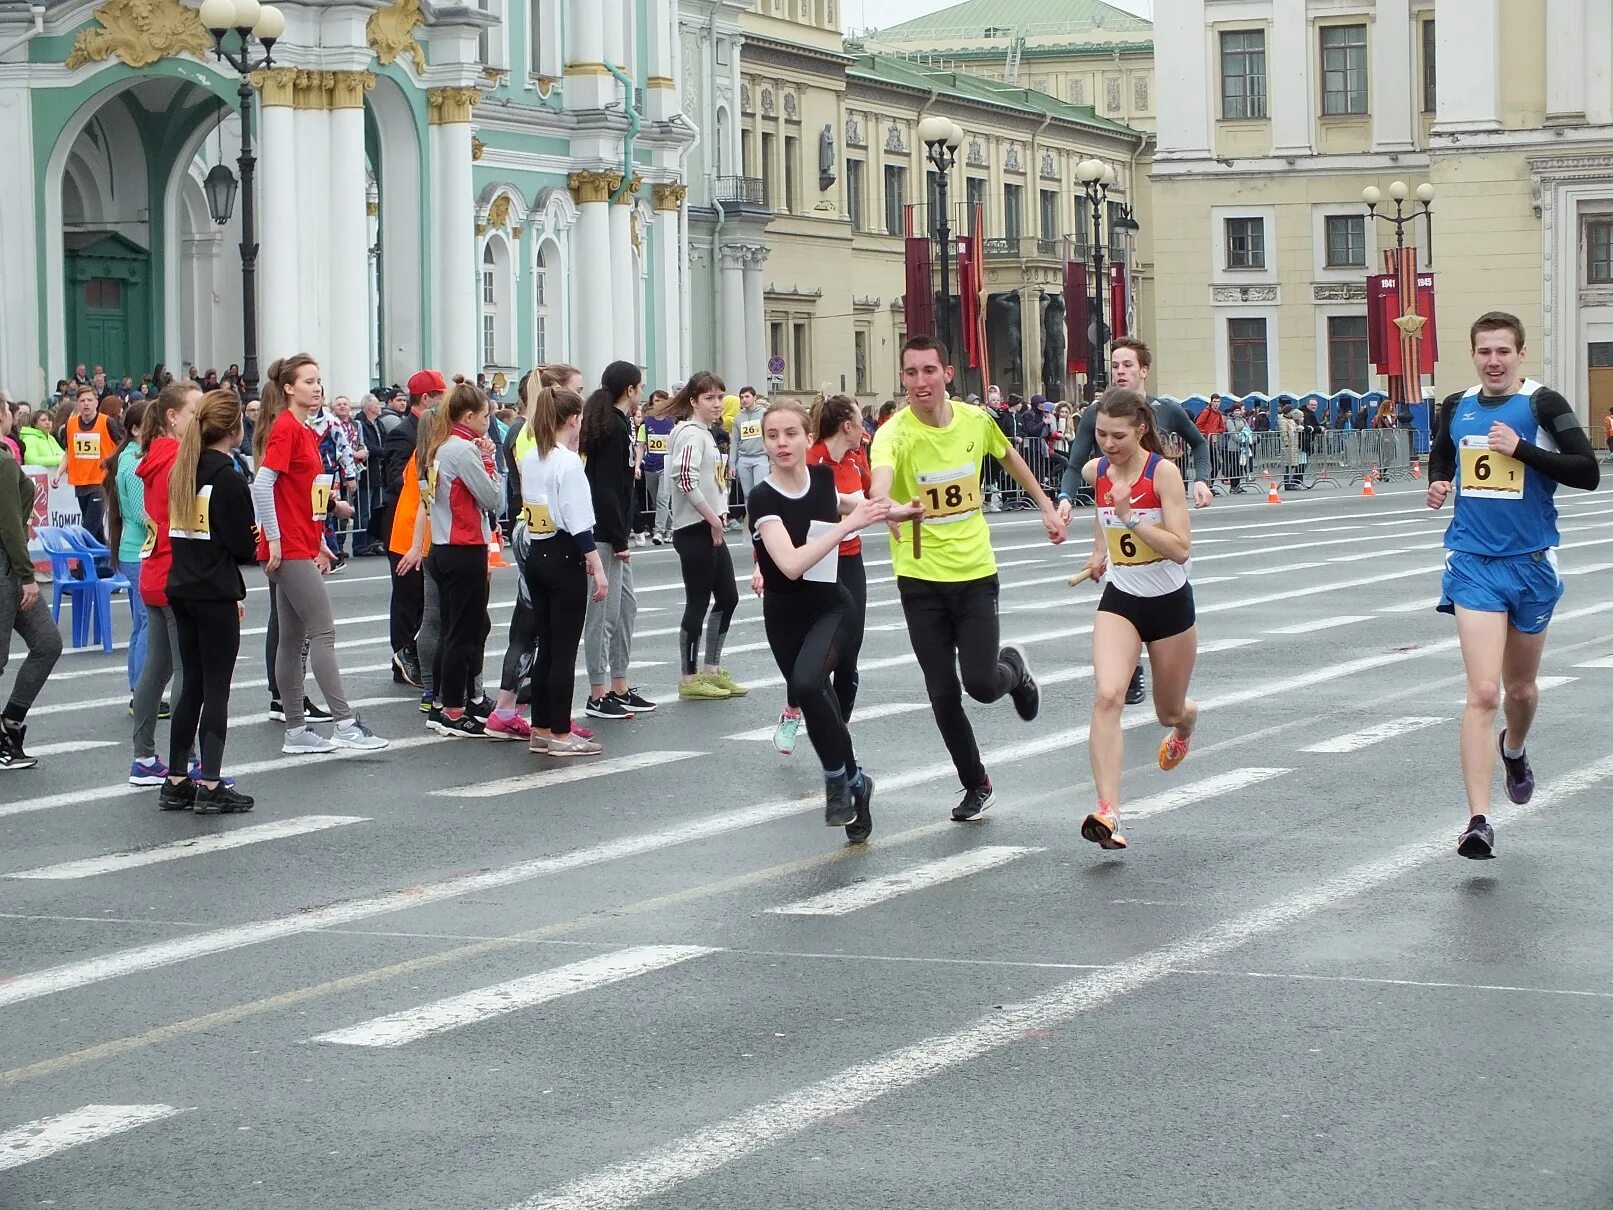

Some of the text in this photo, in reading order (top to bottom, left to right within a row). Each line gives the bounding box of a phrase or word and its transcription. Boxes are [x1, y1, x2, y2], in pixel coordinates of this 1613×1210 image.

[1381, 279, 1396, 288] 1941
[1417, 277, 1432, 287] 1945
[742, 425, 755, 435] 26
[76, 441, 91, 452] 15
[650, 440, 662, 449] 20
[1475, 454, 1515, 481] 6 1
[926, 484, 973, 510] 18 1
[199, 514, 204, 523] 2
[525, 507, 534, 527] 2
[1119, 533, 1137, 558] 6
